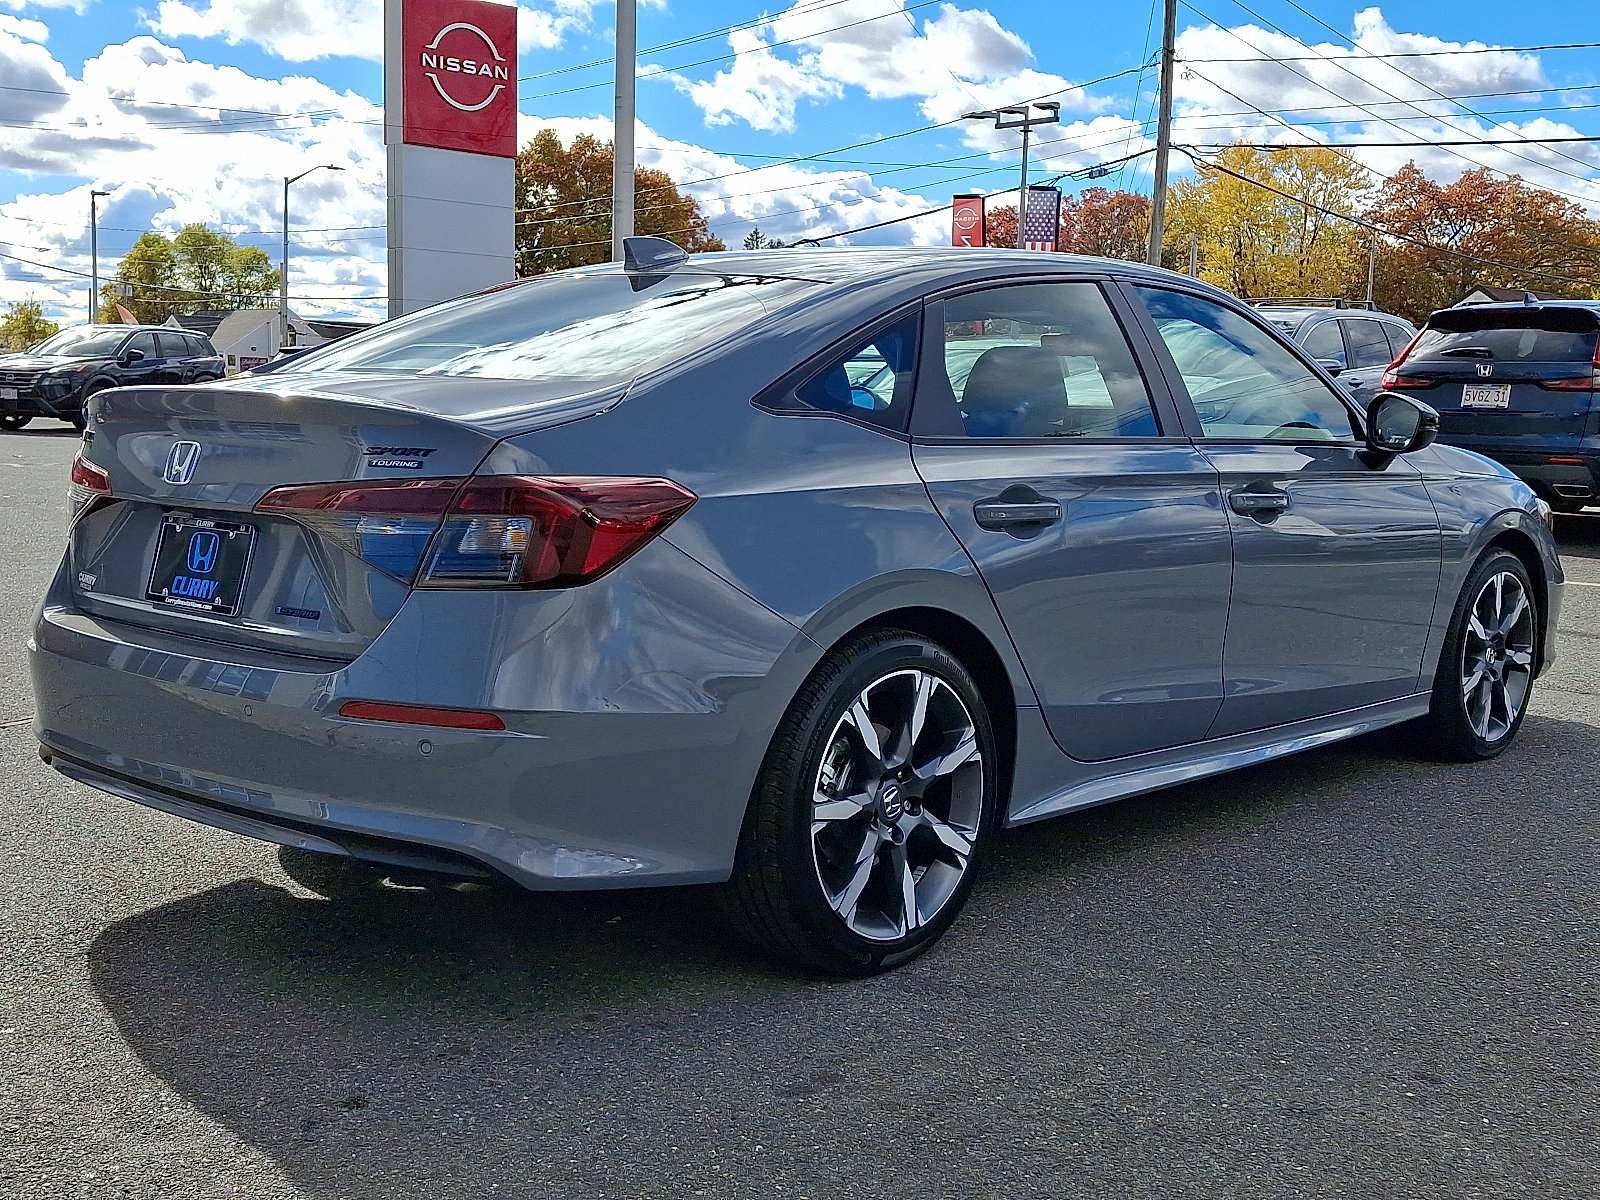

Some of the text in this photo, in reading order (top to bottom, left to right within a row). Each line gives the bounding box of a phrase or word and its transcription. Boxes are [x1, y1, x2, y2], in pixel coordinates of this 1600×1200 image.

[422, 52, 508, 81] NISSAN
[1465, 390, 1507, 402] 5VGZ 31
[363, 446, 437, 458] SPORT
[371, 460, 419, 468] TOURING
[196, 519, 216, 528] CURRY
[171, 575, 219, 599] CURRY
